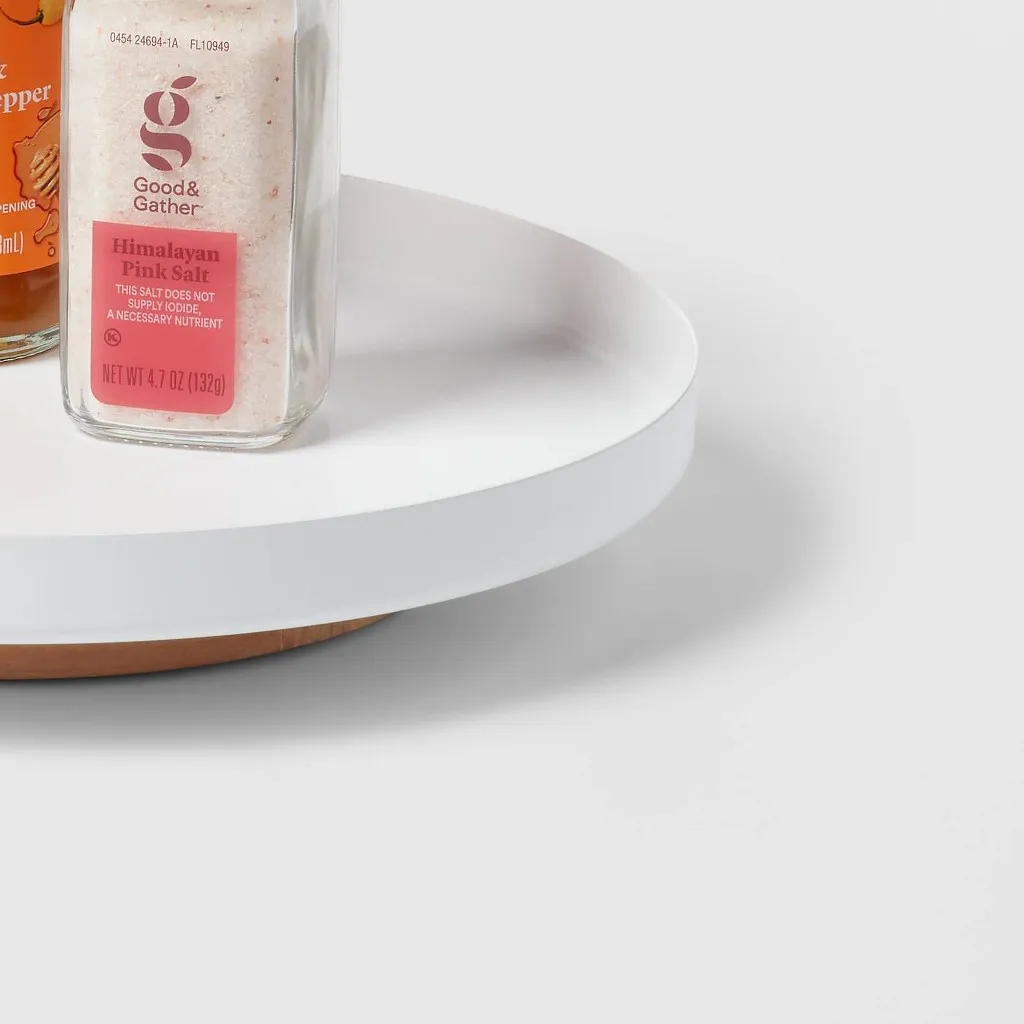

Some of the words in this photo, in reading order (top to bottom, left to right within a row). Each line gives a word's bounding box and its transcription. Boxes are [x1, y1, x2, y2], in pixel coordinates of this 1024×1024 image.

[110, 32, 132, 44] 0454
[134, 34, 179, 48] 24694-1A
[190, 39, 230, 52] FL10949
[133, 176, 200, 197] Good&
[112, 237, 220, 264] Himalayan
[121, 260, 168, 281] Pink
[172, 265, 210, 284] Salt
[115, 284, 137, 296] THIS
[139, 286, 163, 298] SALT
[165, 289, 191, 301] DOES
[193, 290, 215, 302] NOT
[128, 299, 163, 312] SUPPLY
[165, 302, 202, 316] IODIDE,
[107, 309, 115, 319] A
[116, 309, 173, 325] NECESSARY
[175, 315, 224, 329] NUTRIENT
[102, 363, 124, 385] NET
[126, 366, 144, 387] WT
[147, 368, 166, 389] 4.7
[169, 371, 184, 392] OZ
[188, 371, 226, 397] (132g)
